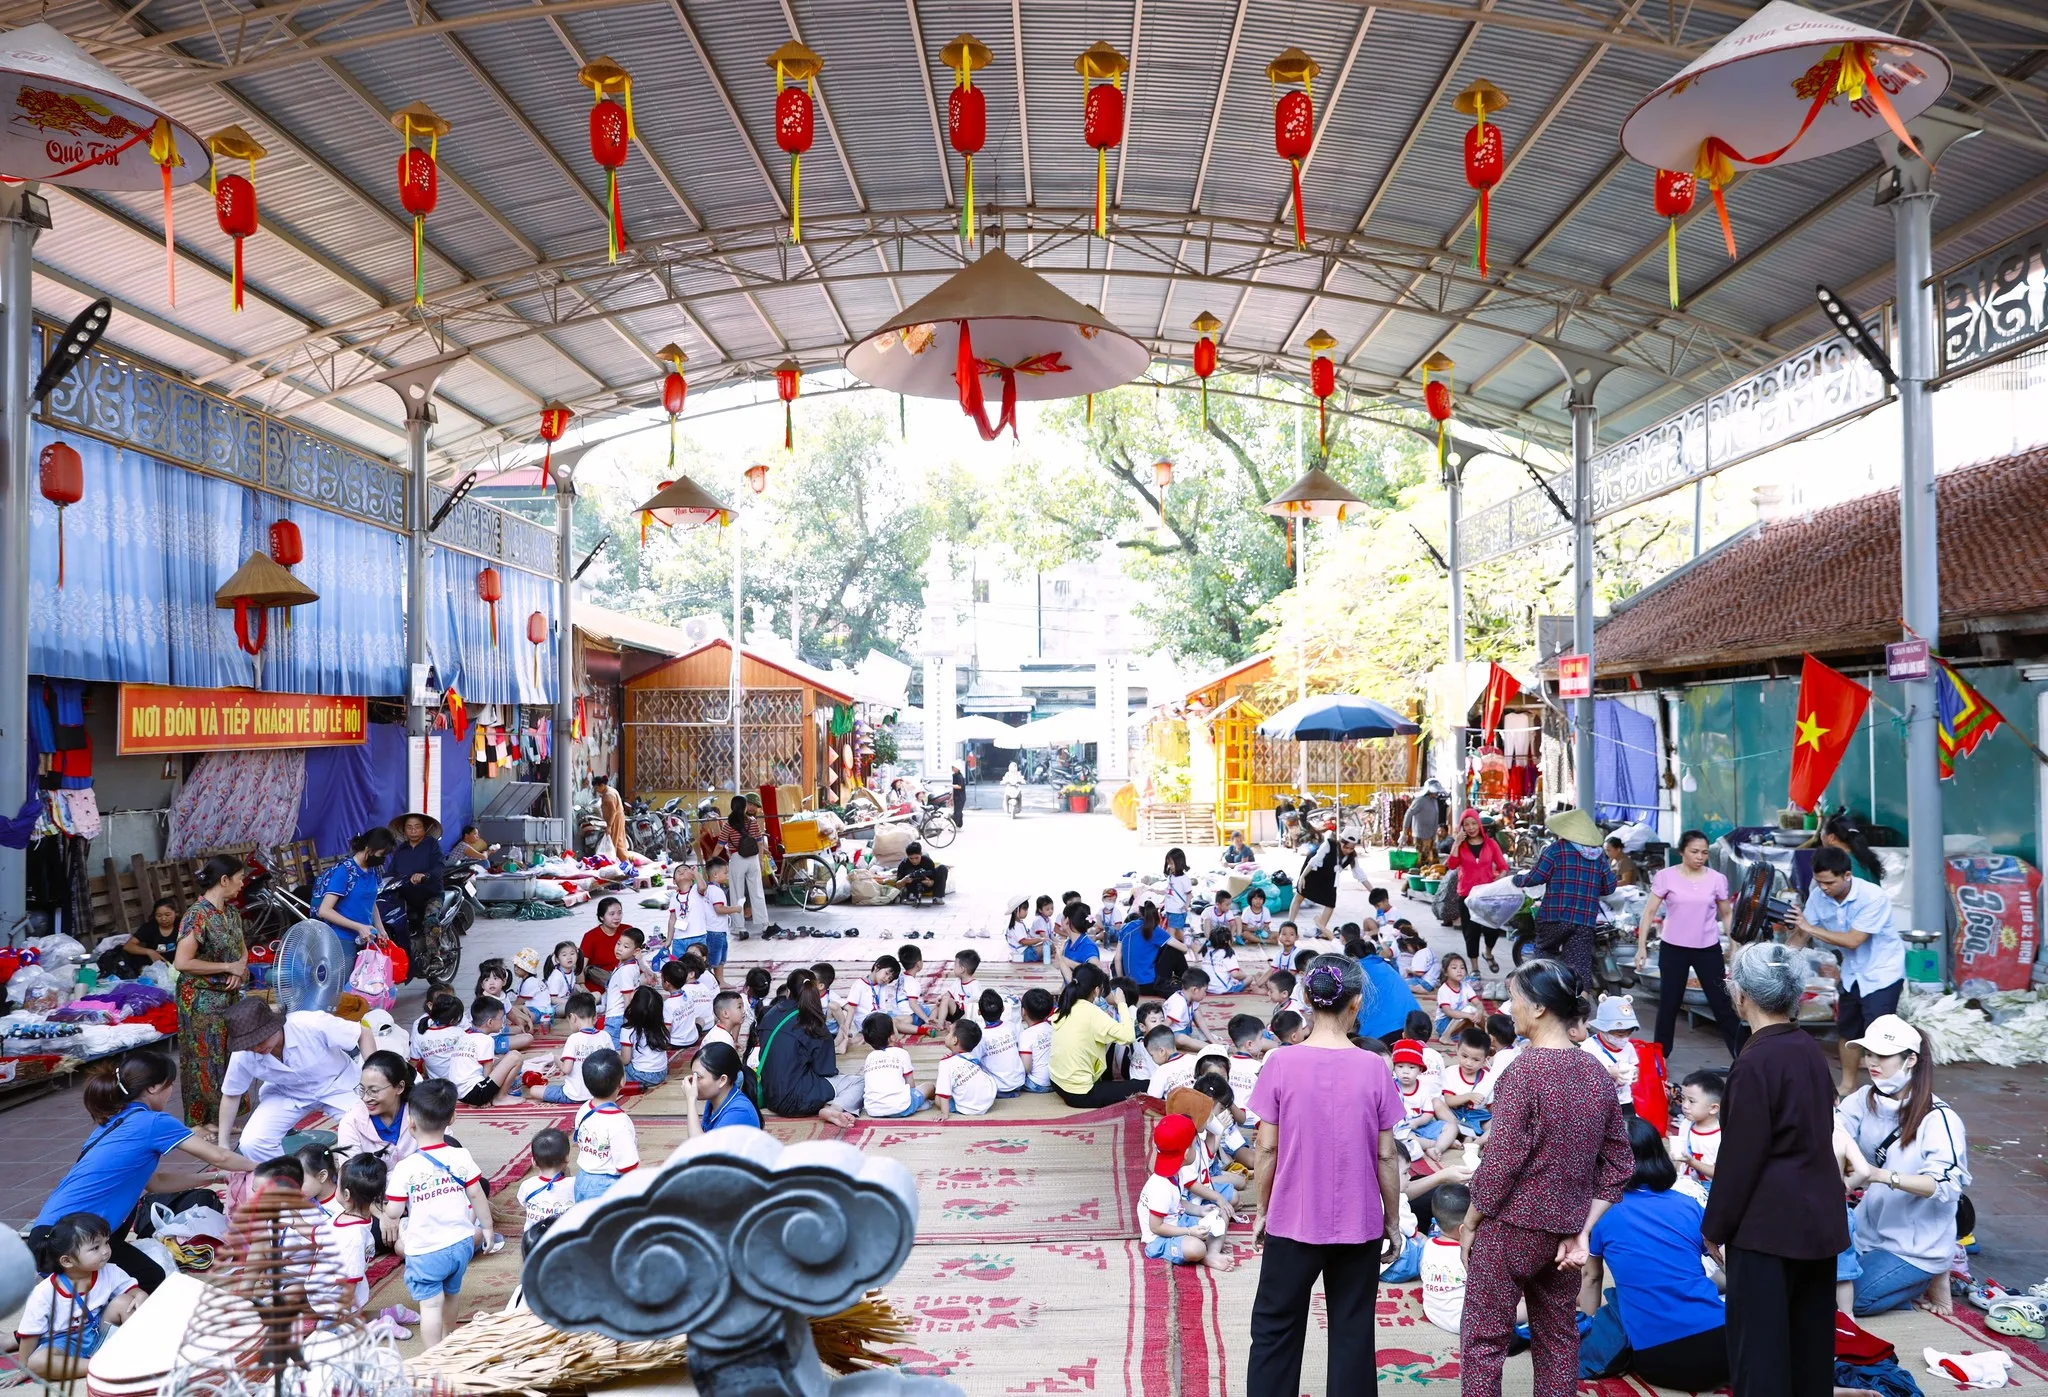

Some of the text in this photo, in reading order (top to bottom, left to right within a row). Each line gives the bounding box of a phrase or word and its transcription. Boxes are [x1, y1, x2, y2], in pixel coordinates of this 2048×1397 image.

[45, 139, 86, 165] Quê
[132, 698, 361, 739] NƠI ĐÓN VÀ TIẾP KHÁCH VỀ DỰ LỄ HỘI
[2019, 904, 2034, 923] LED
[2021, 924, 2034, 938] 32
[2017, 940, 2033, 964] INCH
